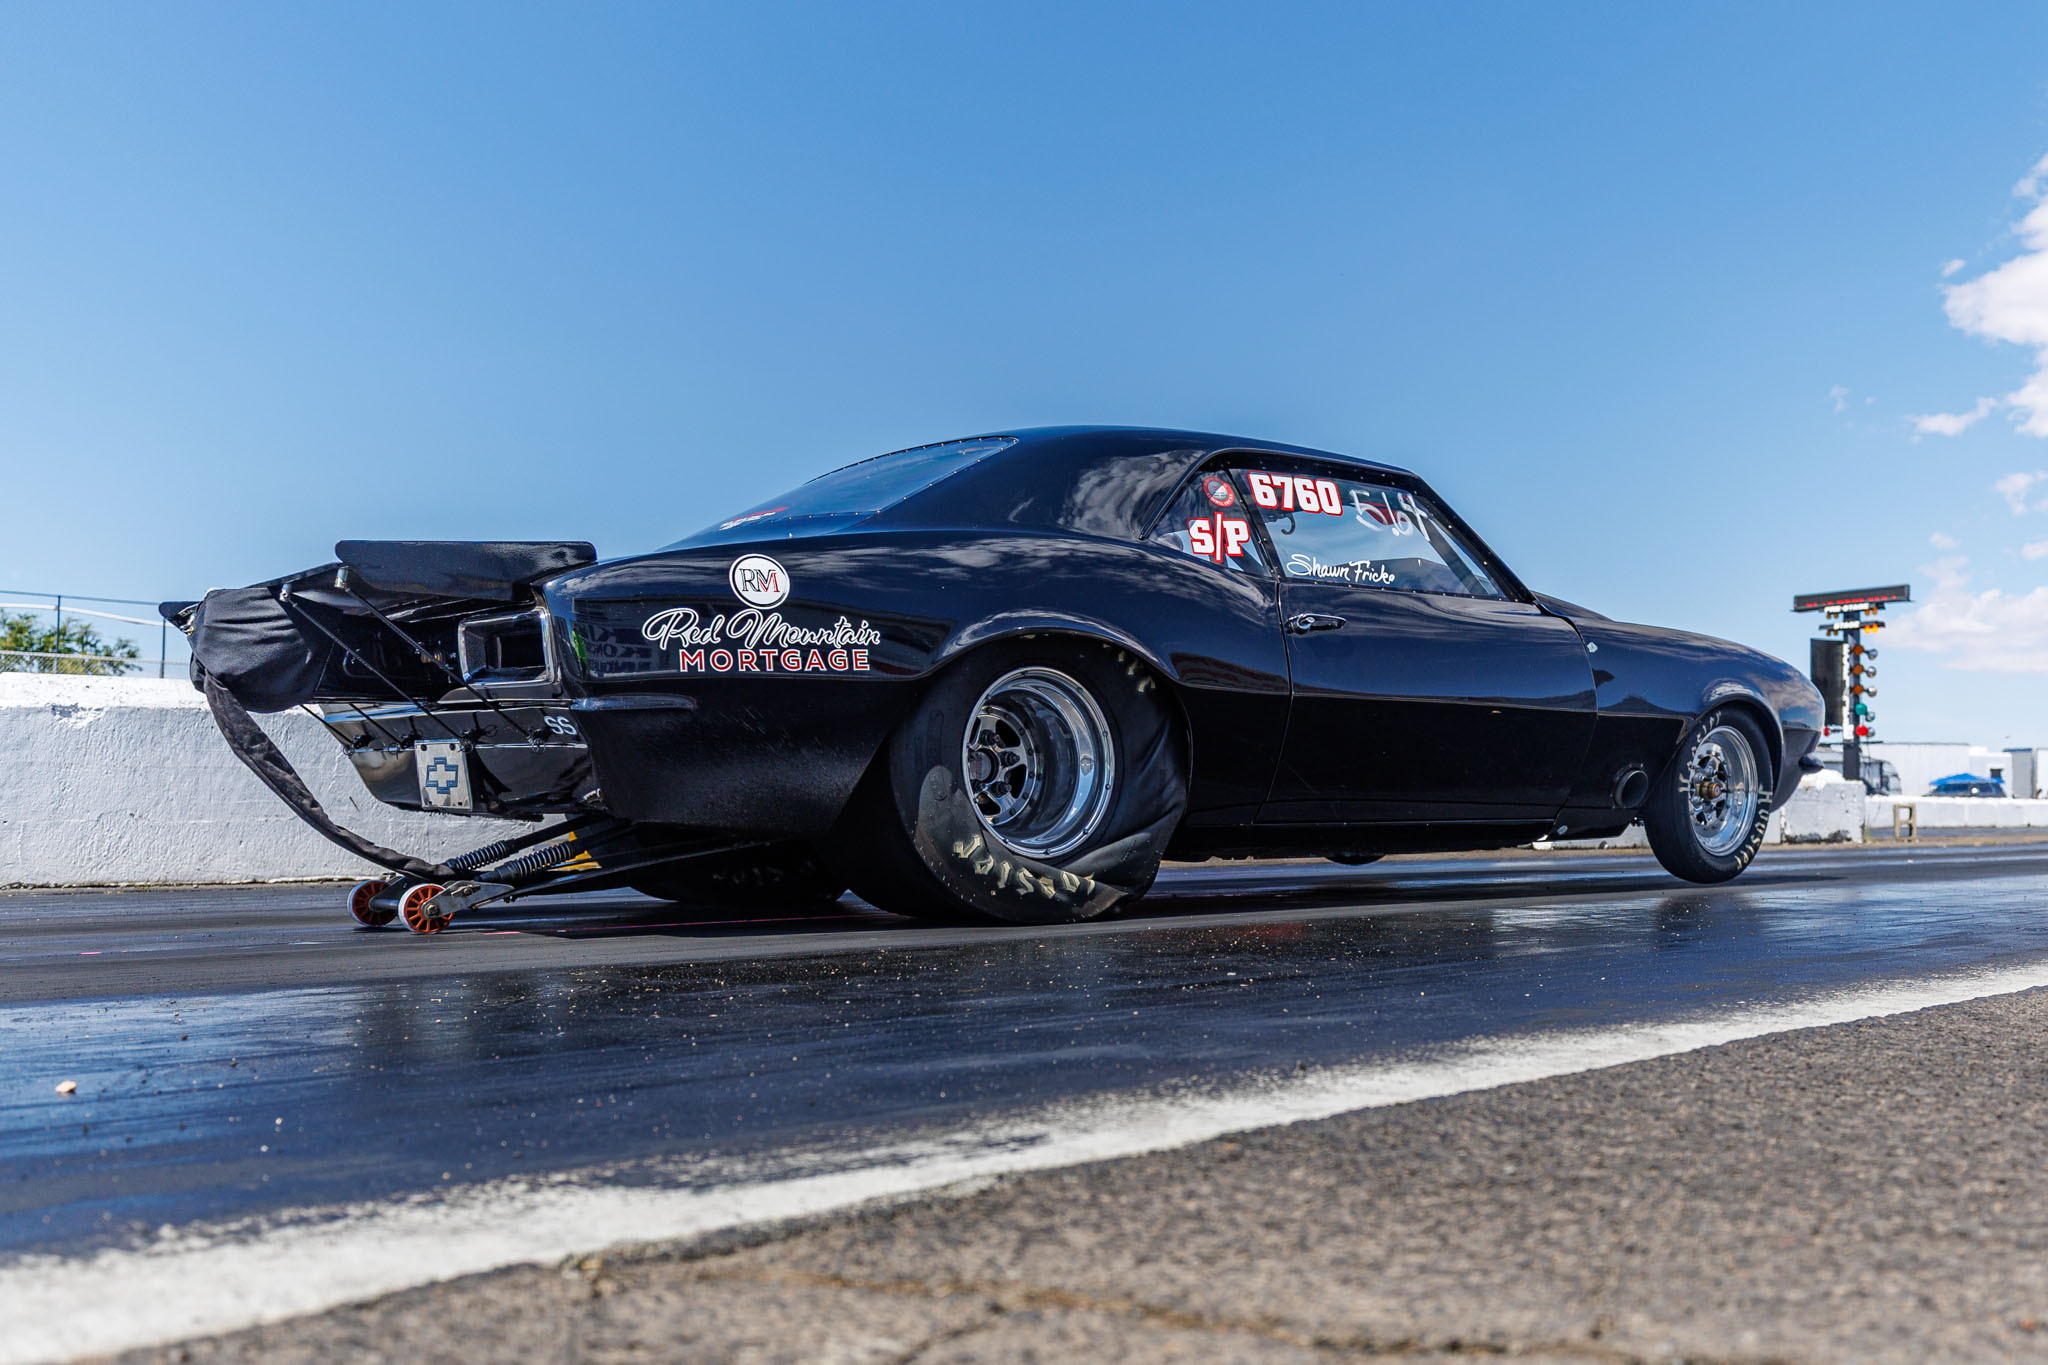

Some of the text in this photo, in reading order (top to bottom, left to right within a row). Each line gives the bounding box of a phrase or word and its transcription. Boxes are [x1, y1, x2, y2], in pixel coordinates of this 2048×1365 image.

[1247, 470, 1343, 516] 6760
[1186, 512, 1251, 563] S/P
[739, 568, 780, 593] RM
[1286, 553, 1350, 581] Shawn
[642, 607, 726, 650] Red
[726, 608, 881, 649] Mountain
[679, 649, 871, 672] MORTGAGE
[544, 715, 577, 735] SS
